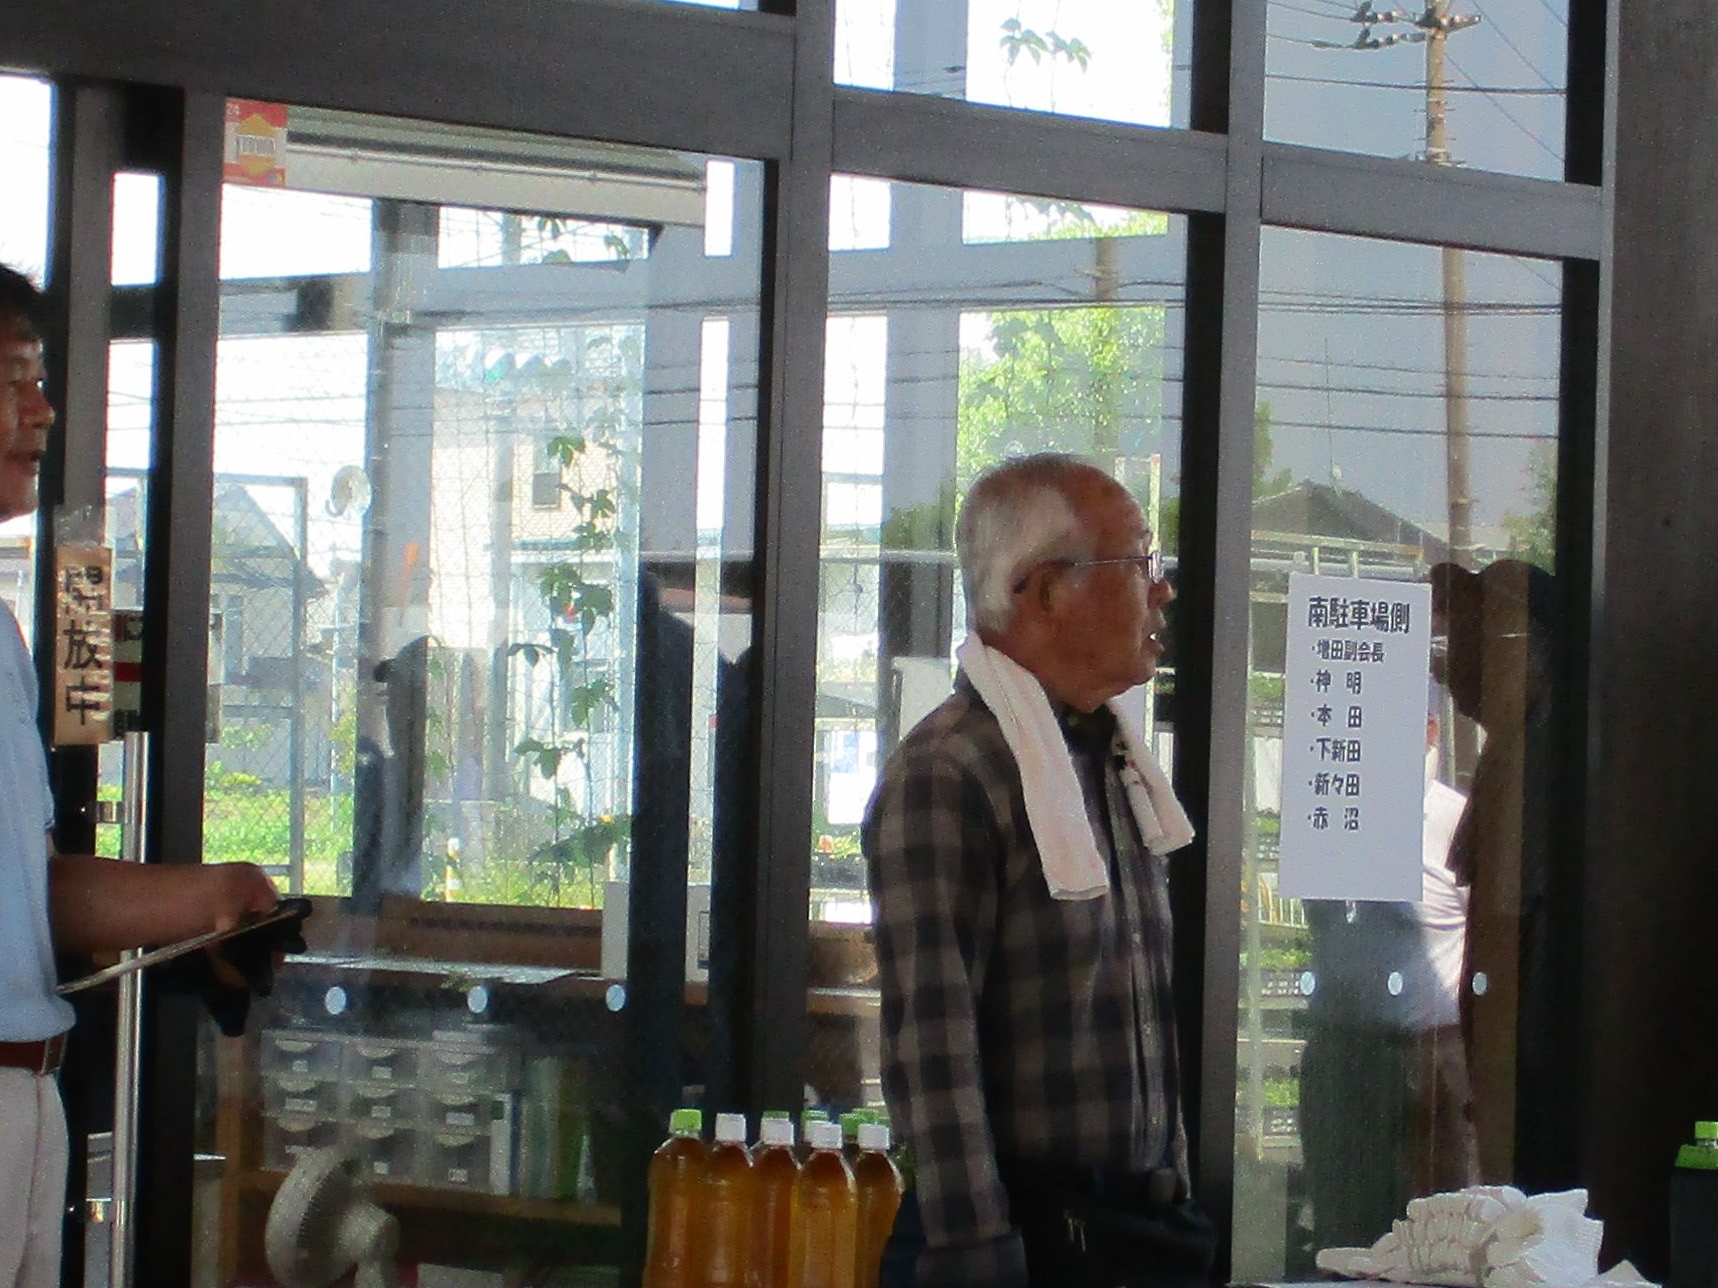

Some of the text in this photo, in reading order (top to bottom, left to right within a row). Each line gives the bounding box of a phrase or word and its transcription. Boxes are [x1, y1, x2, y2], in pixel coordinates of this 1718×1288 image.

[63, 566, 103, 726] 開放中
[1308, 596, 1410, 633] 南駐車場側
